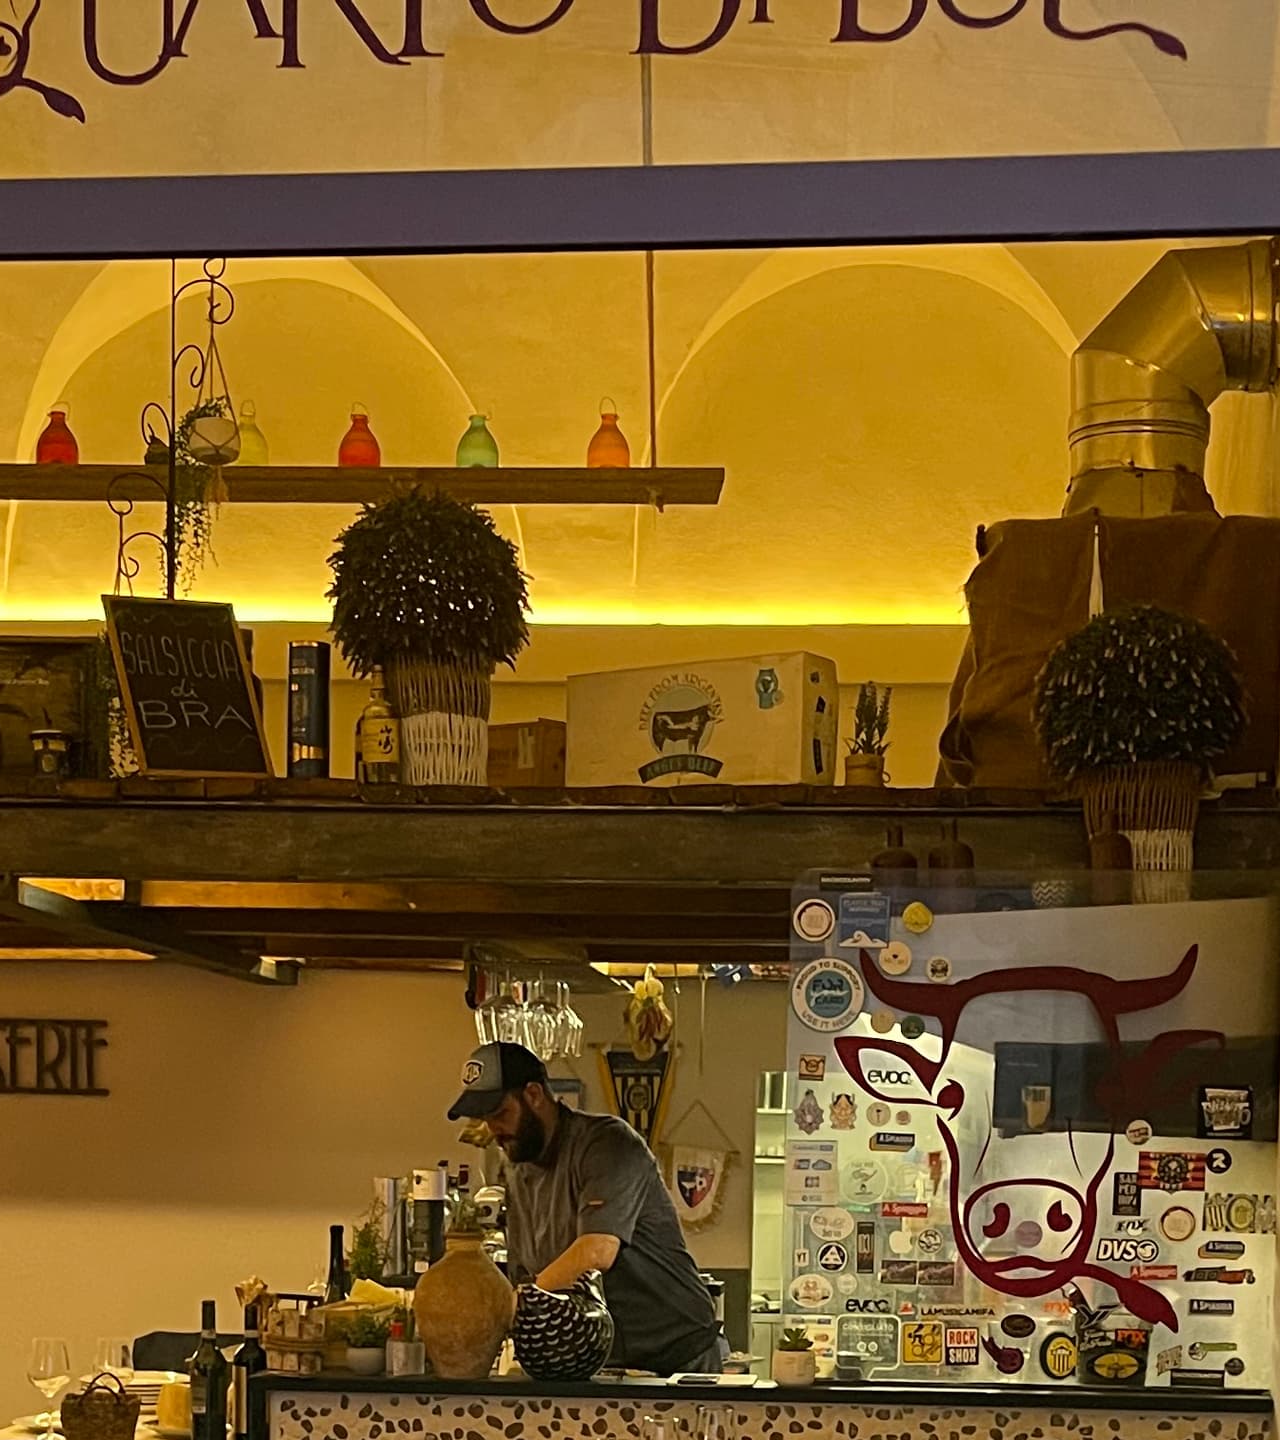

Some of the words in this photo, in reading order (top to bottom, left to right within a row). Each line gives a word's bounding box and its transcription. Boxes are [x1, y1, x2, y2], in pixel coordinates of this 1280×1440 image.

[120, 631, 241, 681] SALSICCIA
[171, 678, 199, 698] di
[138, 700, 253, 730] BRA
[1097, 1239, 1138, 1261] DVS
[949, 1330, 977, 1346] ROCK
[948, 1348, 977, 1364] SHOX
